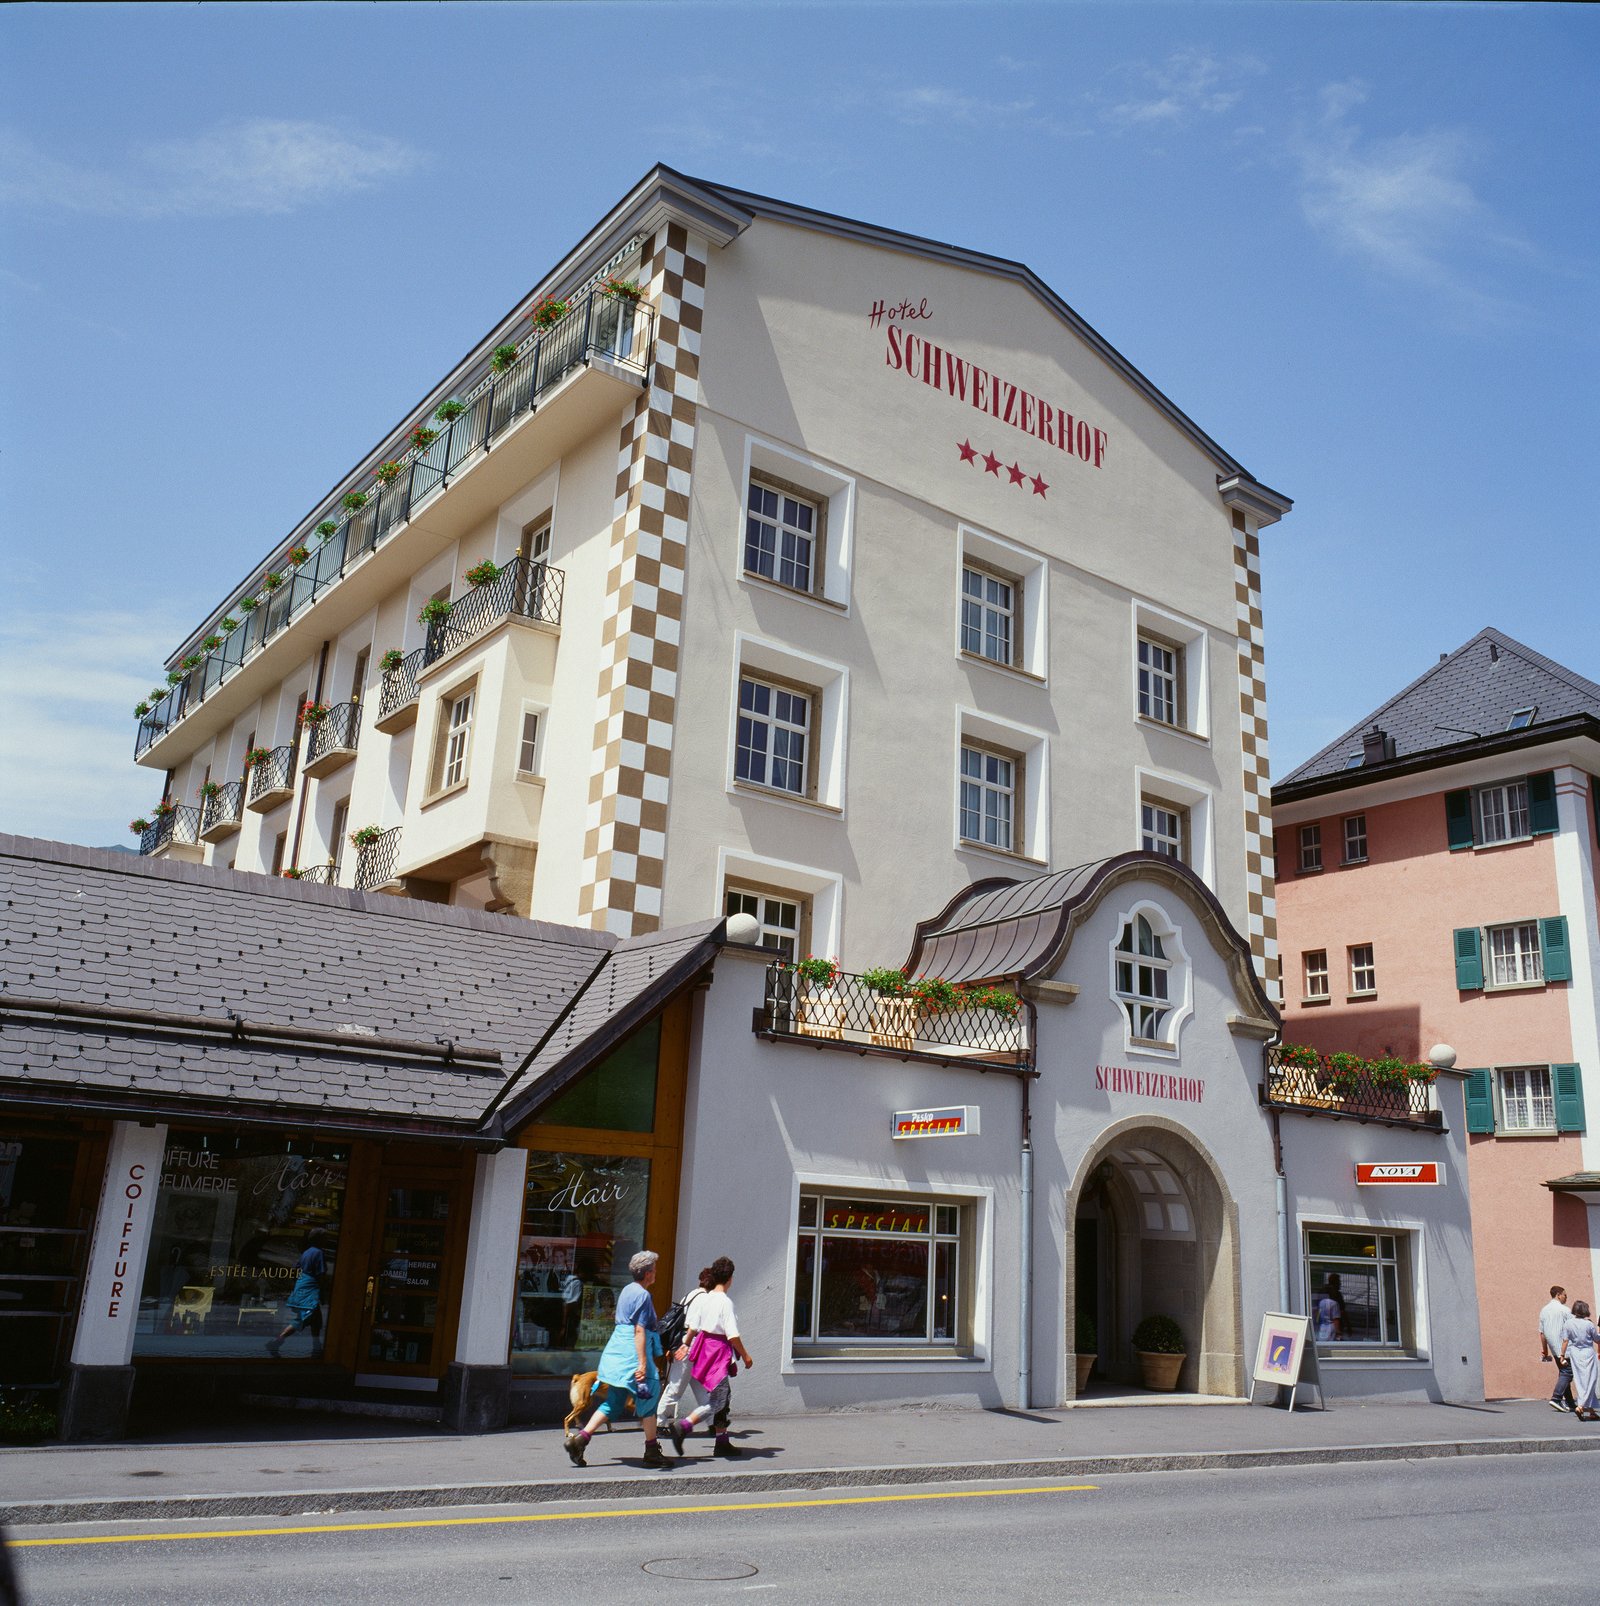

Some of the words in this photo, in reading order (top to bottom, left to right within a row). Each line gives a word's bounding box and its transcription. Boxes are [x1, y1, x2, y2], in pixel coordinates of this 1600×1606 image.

[867, 297, 933, 330] Hotel
[886, 324, 1108, 470] SCHWEIZERHOF
[1095, 1065, 1205, 1103] SCHWEIZERHOF
[901, 1121, 959, 1136] SPECIAL
[162, 1150, 220, 1169] IFFURE
[1375, 1167, 1416, 1176] NOVA
[548, 1170, 629, 1212] Hair
[830, 1214, 923, 1232] SPECIAL
[108, 1164, 145, 1317] COIFFURE
[251, 1266, 303, 1279] LAUDER
[406, 1278, 429, 1286] SALON
